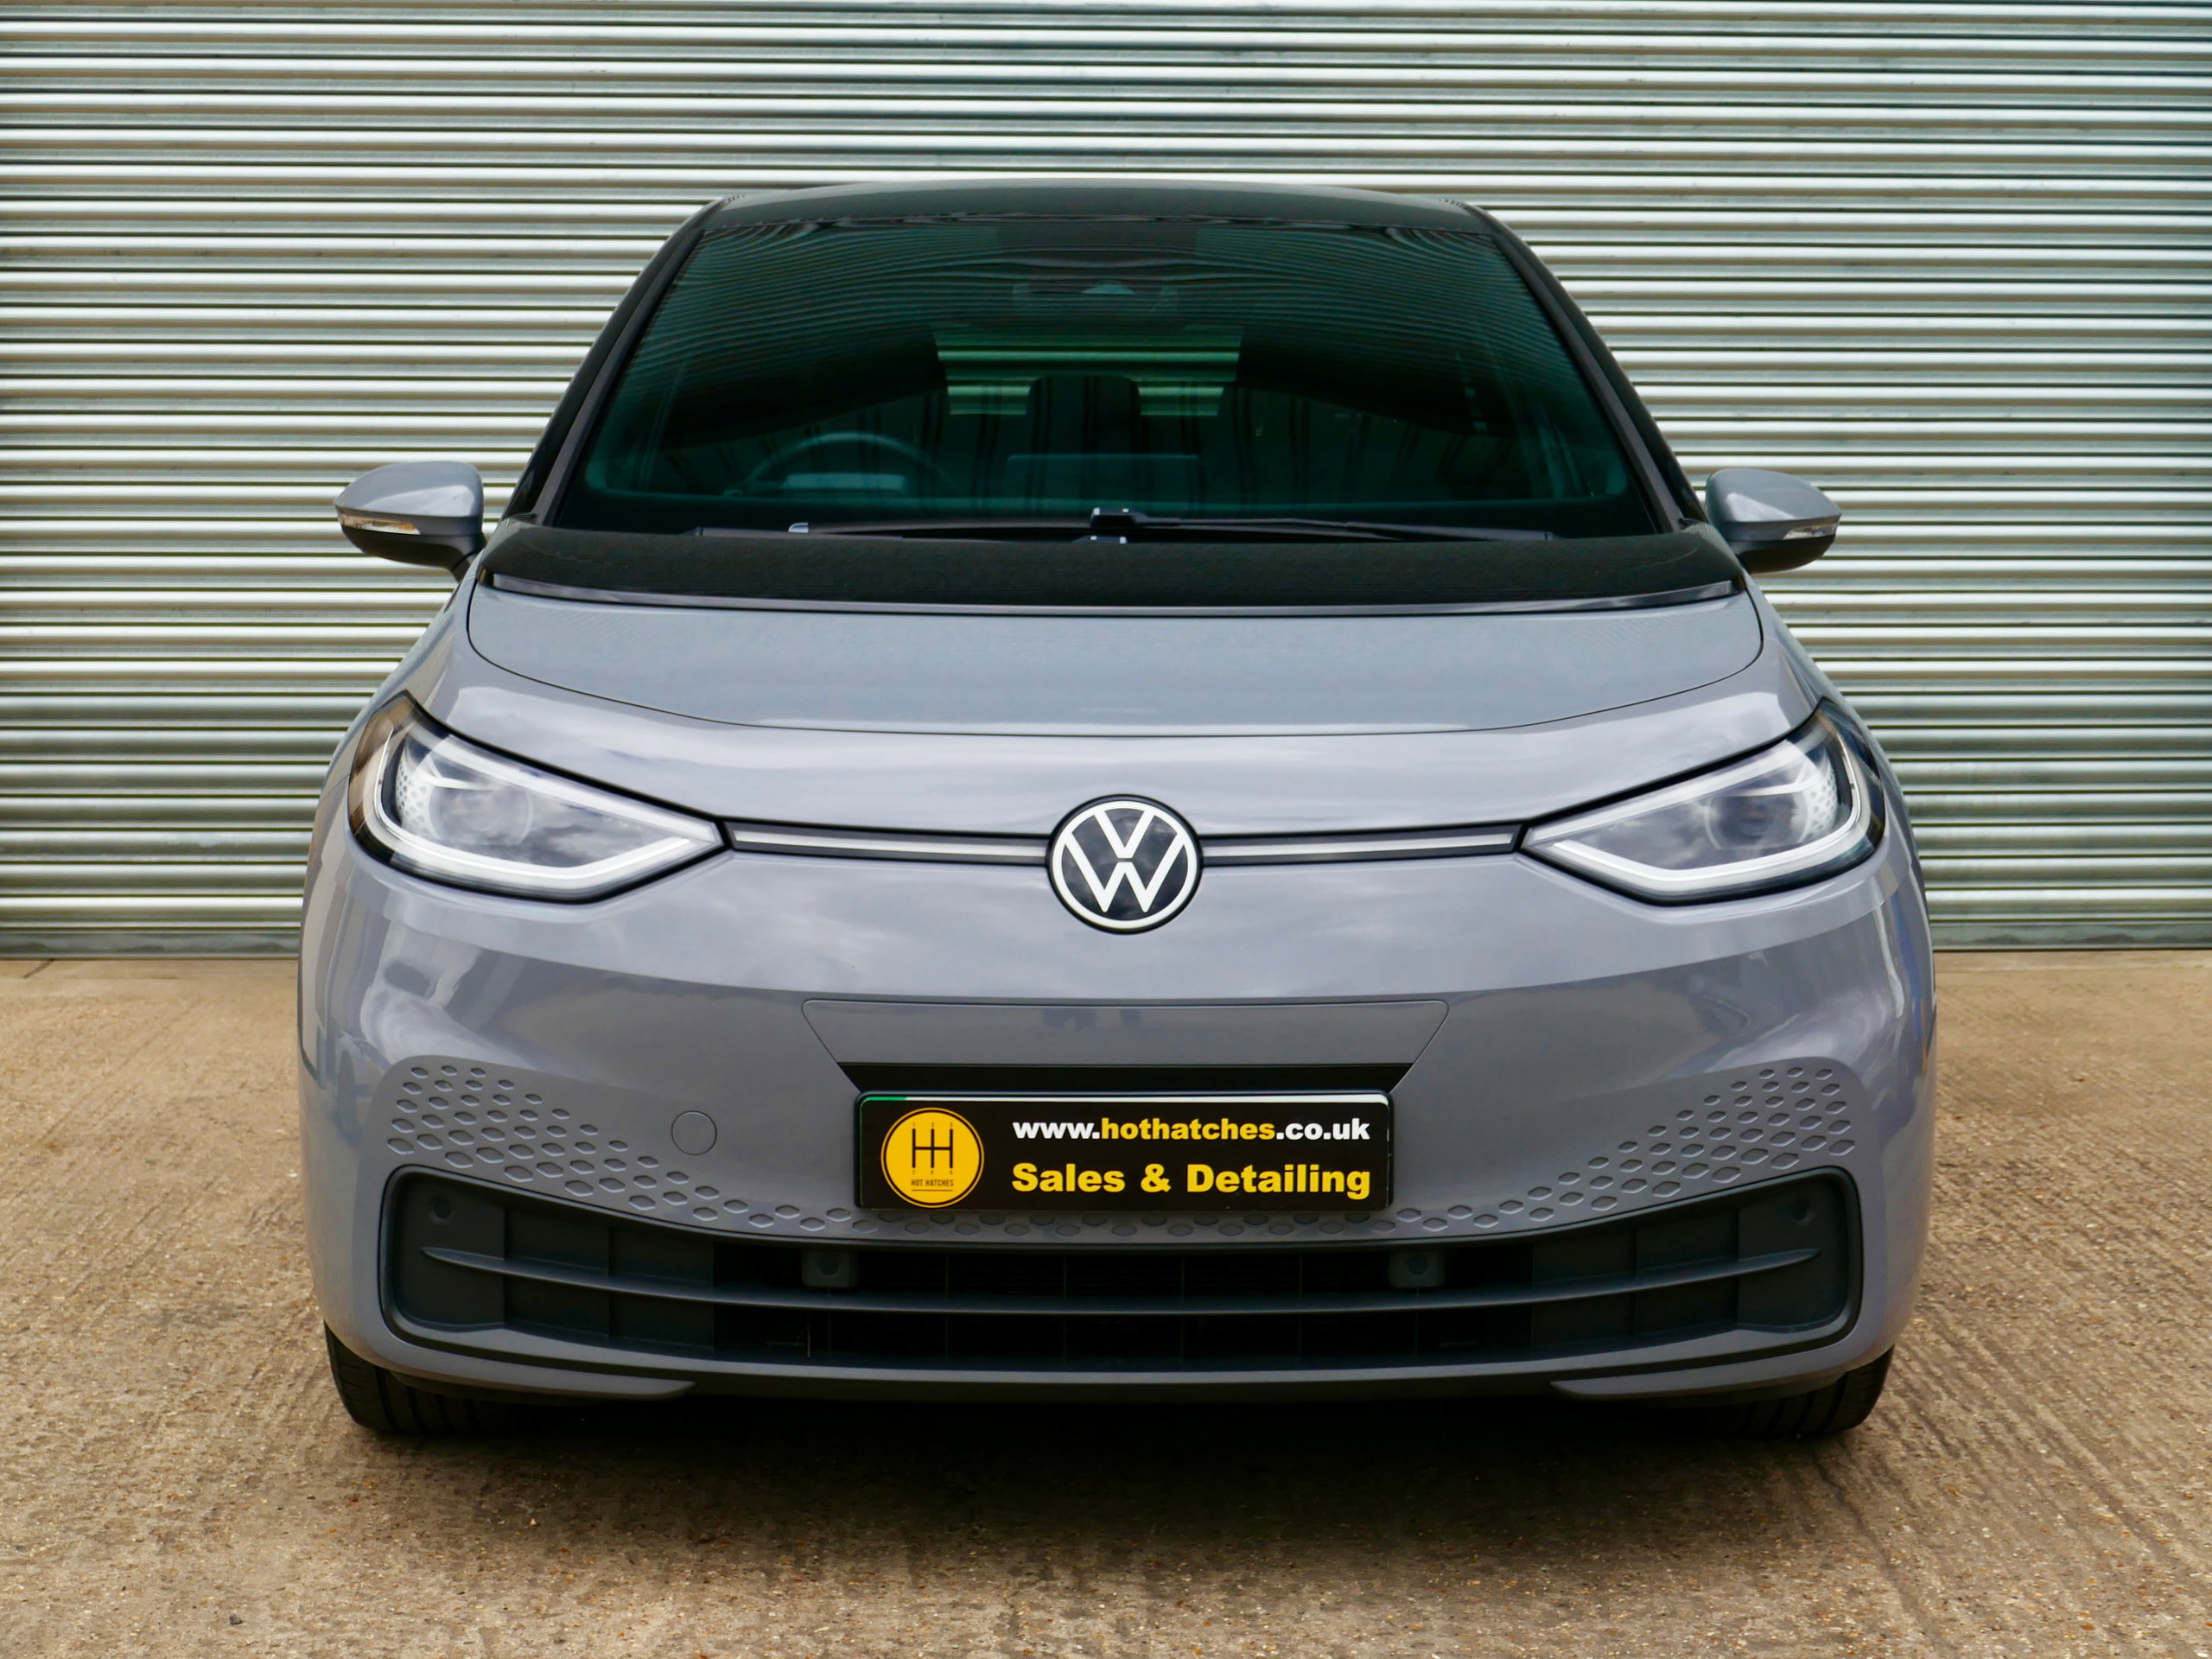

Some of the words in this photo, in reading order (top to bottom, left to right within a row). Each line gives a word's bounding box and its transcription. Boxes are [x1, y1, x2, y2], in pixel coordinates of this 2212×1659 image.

[1013, 1117, 1370, 1141] www.hothatches.co.uk
[925, 1179, 954, 1187] HATCHES
[1012, 1162, 1126, 1193] Sales
[1140, 1163, 1172, 1193] &
[1186, 1163, 1371, 1200] Detailing
